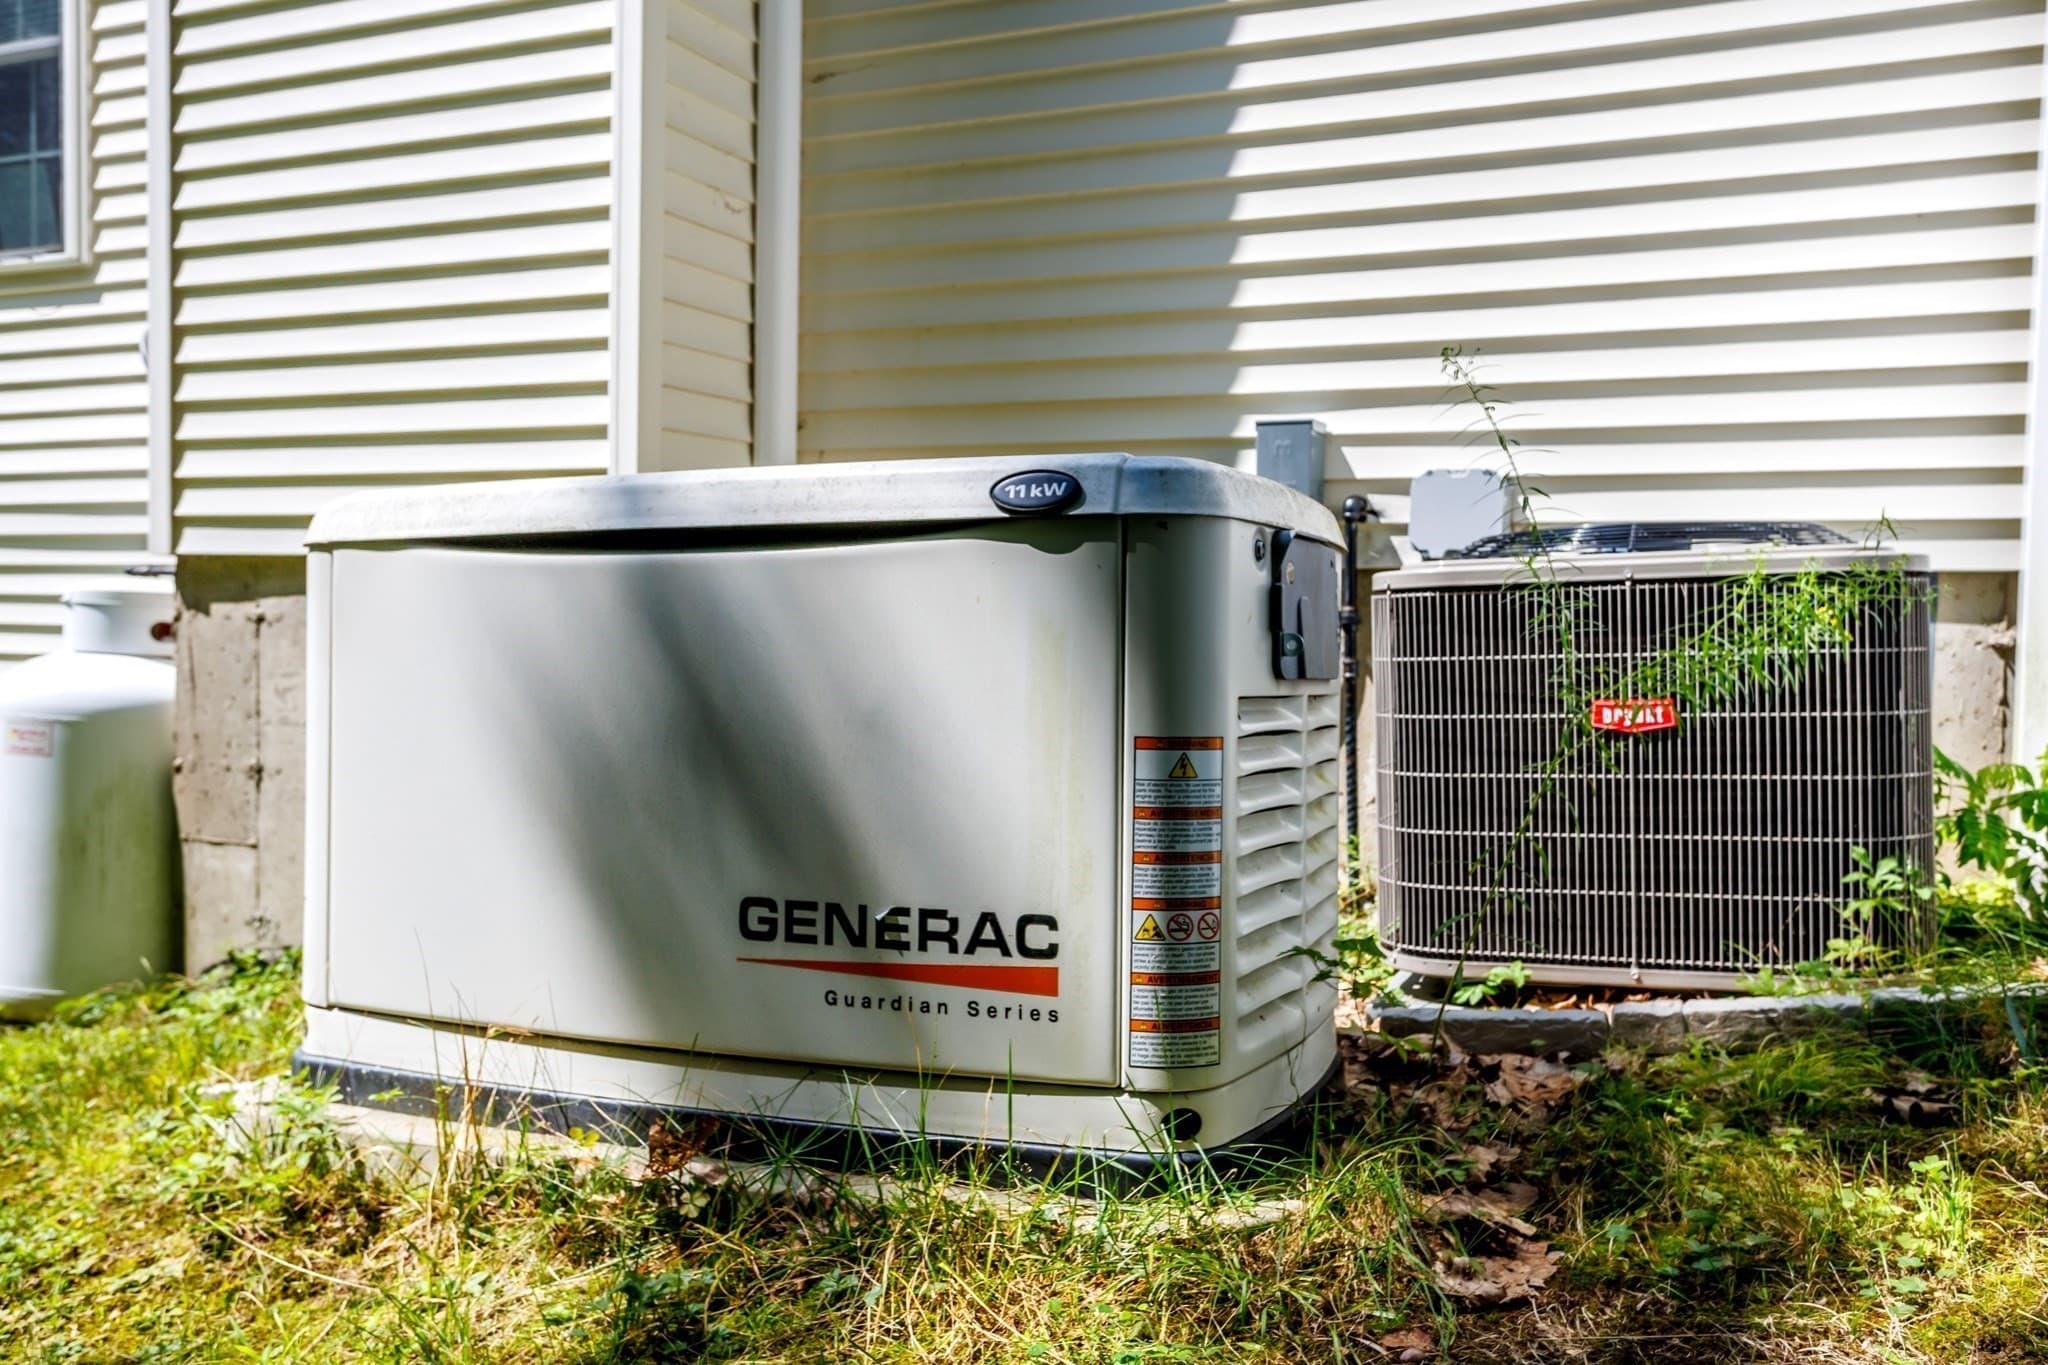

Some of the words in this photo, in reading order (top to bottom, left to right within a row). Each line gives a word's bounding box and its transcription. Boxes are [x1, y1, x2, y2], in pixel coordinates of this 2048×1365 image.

[1005, 484, 1026, 499] 11
[1030, 482, 1067, 497] kW
[738, 896, 1060, 961] GENERAC
[824, 989, 948, 1015] Guardian
[967, 1000, 1060, 1023] Series
